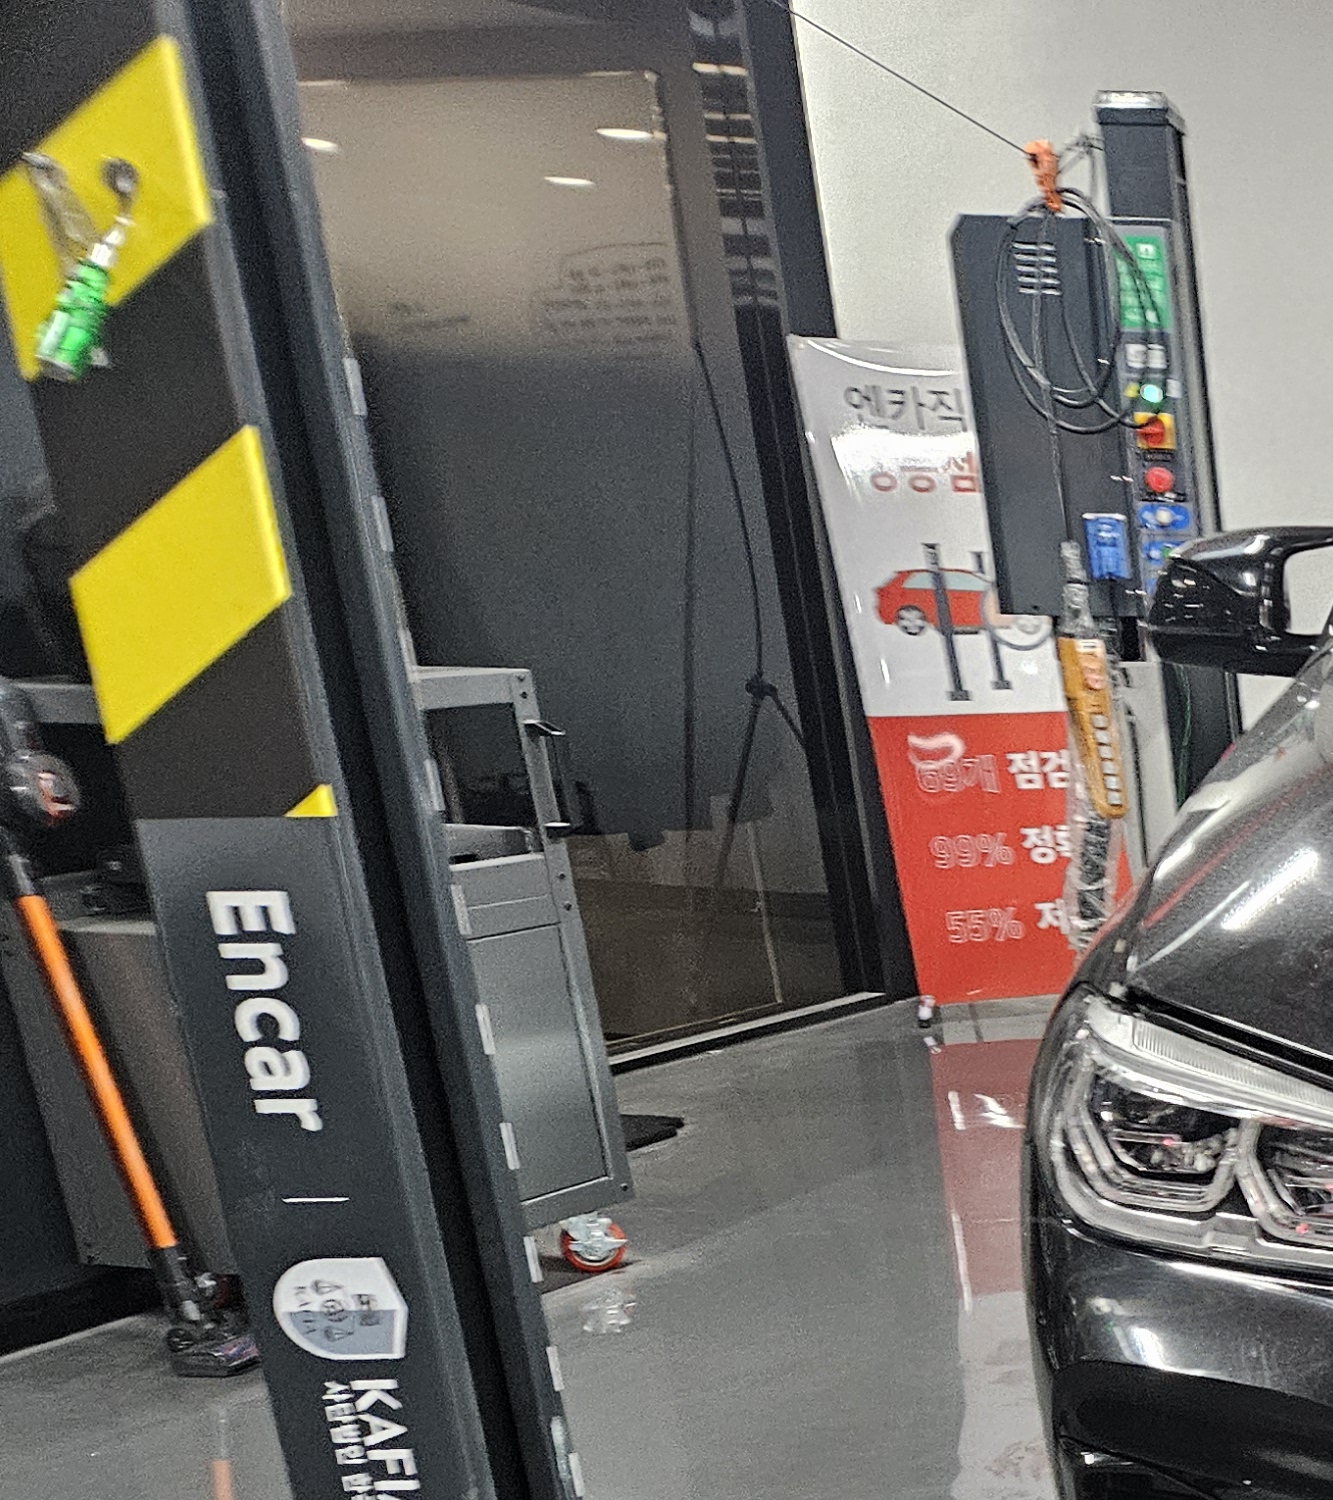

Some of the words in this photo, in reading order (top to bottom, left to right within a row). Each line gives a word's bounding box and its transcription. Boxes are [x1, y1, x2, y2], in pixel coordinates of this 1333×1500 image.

[842, 384, 968, 433] 엔카직
[1005, 748, 1072, 790] 점검
[930, 832, 1016, 869] 99%
[945, 906, 1026, 943] 55%
[205, 889, 324, 1132] Encar
